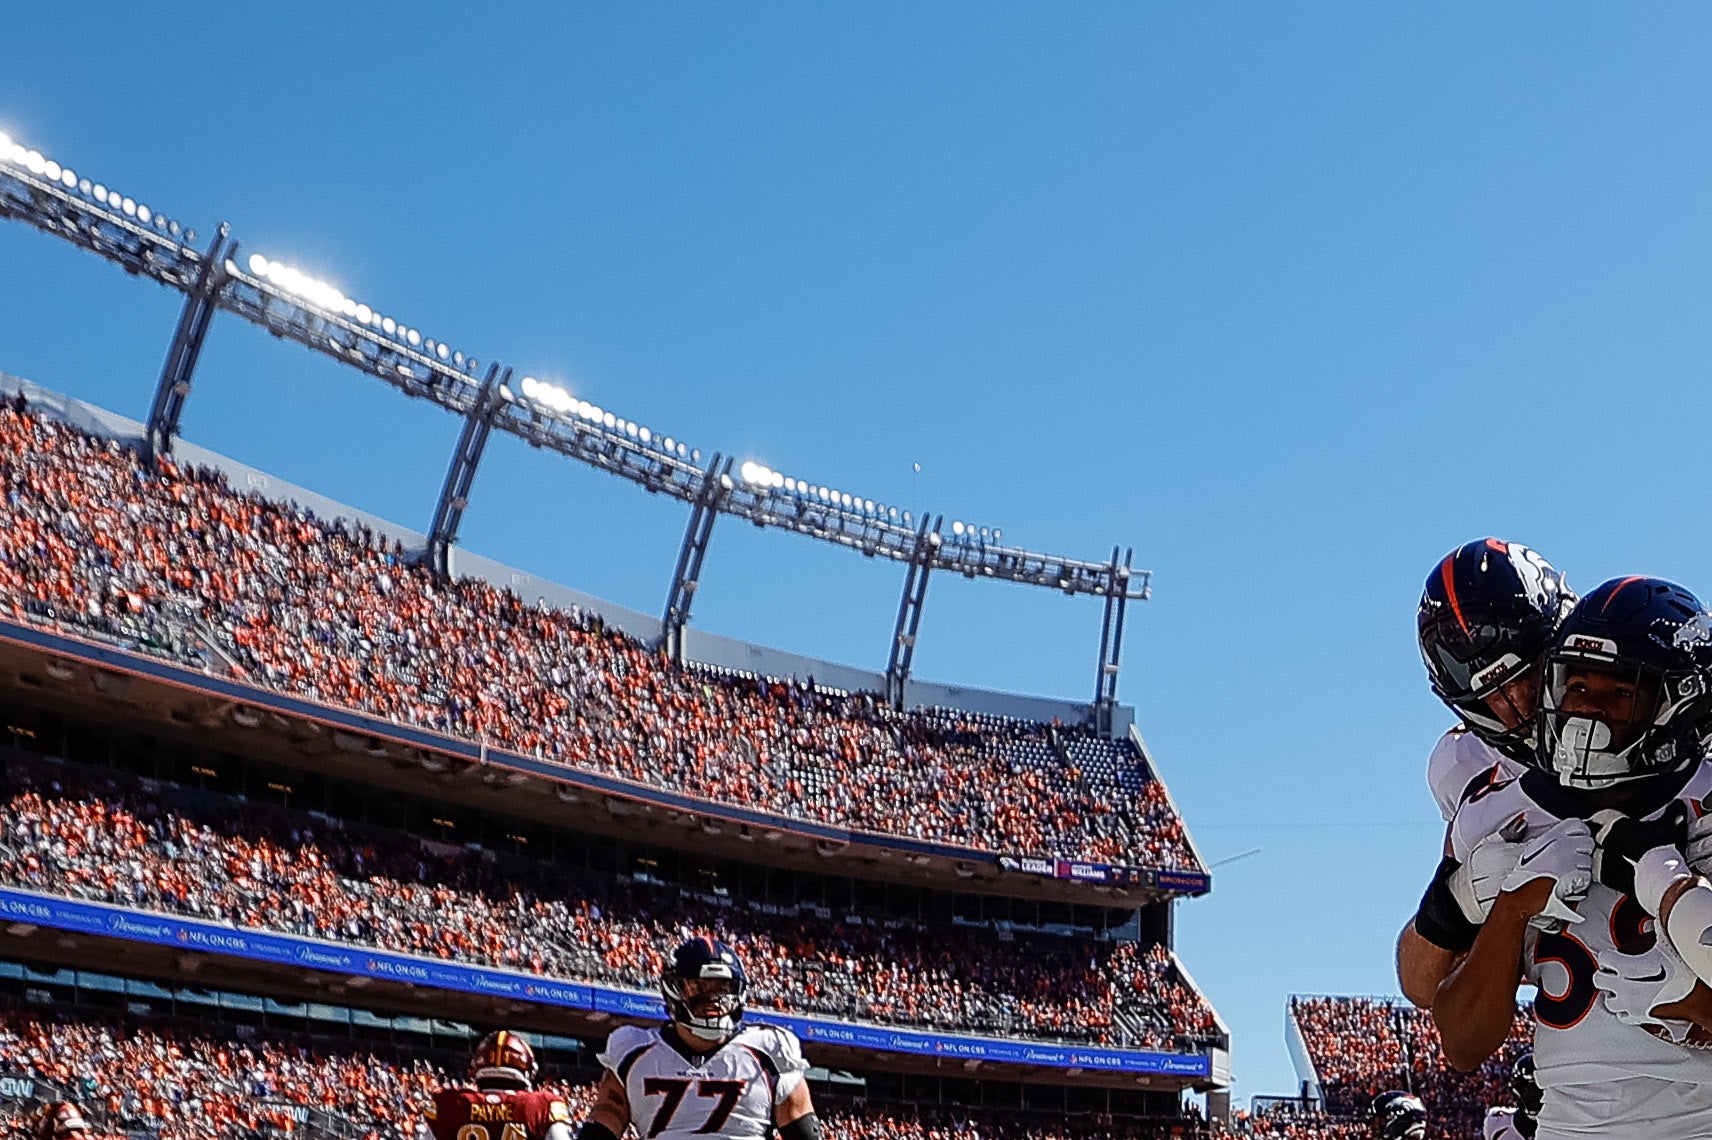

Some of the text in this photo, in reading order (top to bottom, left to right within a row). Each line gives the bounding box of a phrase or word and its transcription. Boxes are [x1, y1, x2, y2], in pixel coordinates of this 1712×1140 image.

[10, 901, 28, 914] ON
[210, 934, 226, 946] ON
[395, 965, 408, 975] ON
[550, 988, 562, 998] ON
[829, 1029, 843, 1039] ON
[958, 1044, 970, 1052] ON
[470, 1102, 514, 1121] PAYNE
[643, 1076, 748, 1138] 77
